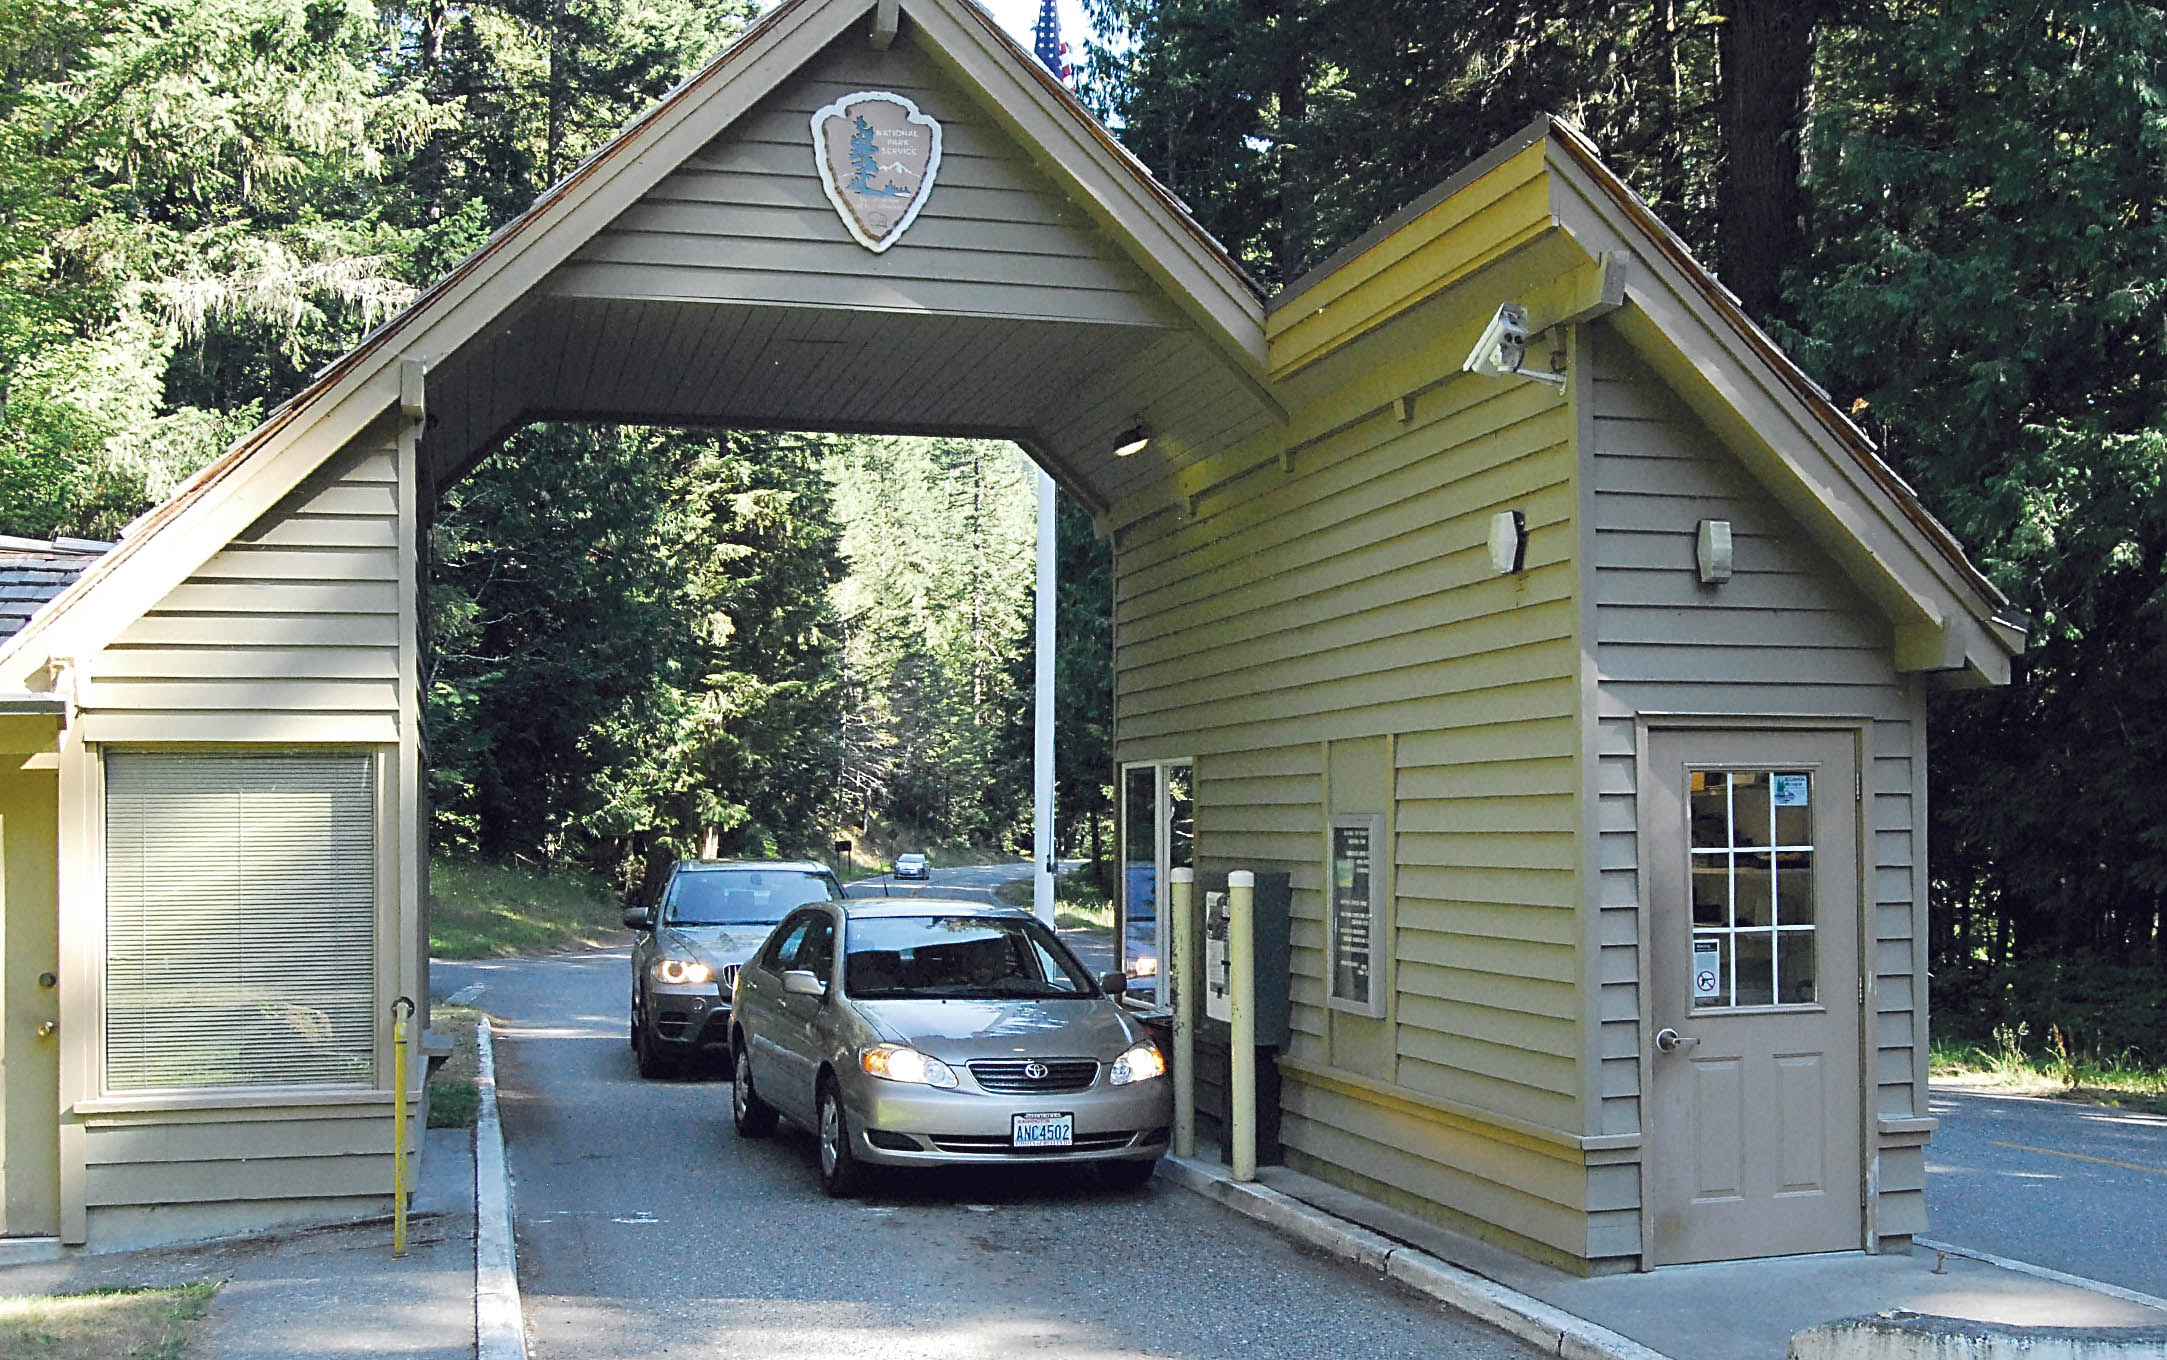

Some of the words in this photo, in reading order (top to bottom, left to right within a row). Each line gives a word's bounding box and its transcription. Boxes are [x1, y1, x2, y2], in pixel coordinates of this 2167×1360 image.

[876, 129, 919, 137] NATIONAL
[881, 147, 918, 156] SERVICE
[1016, 1124, 1070, 1141] ANC4502
